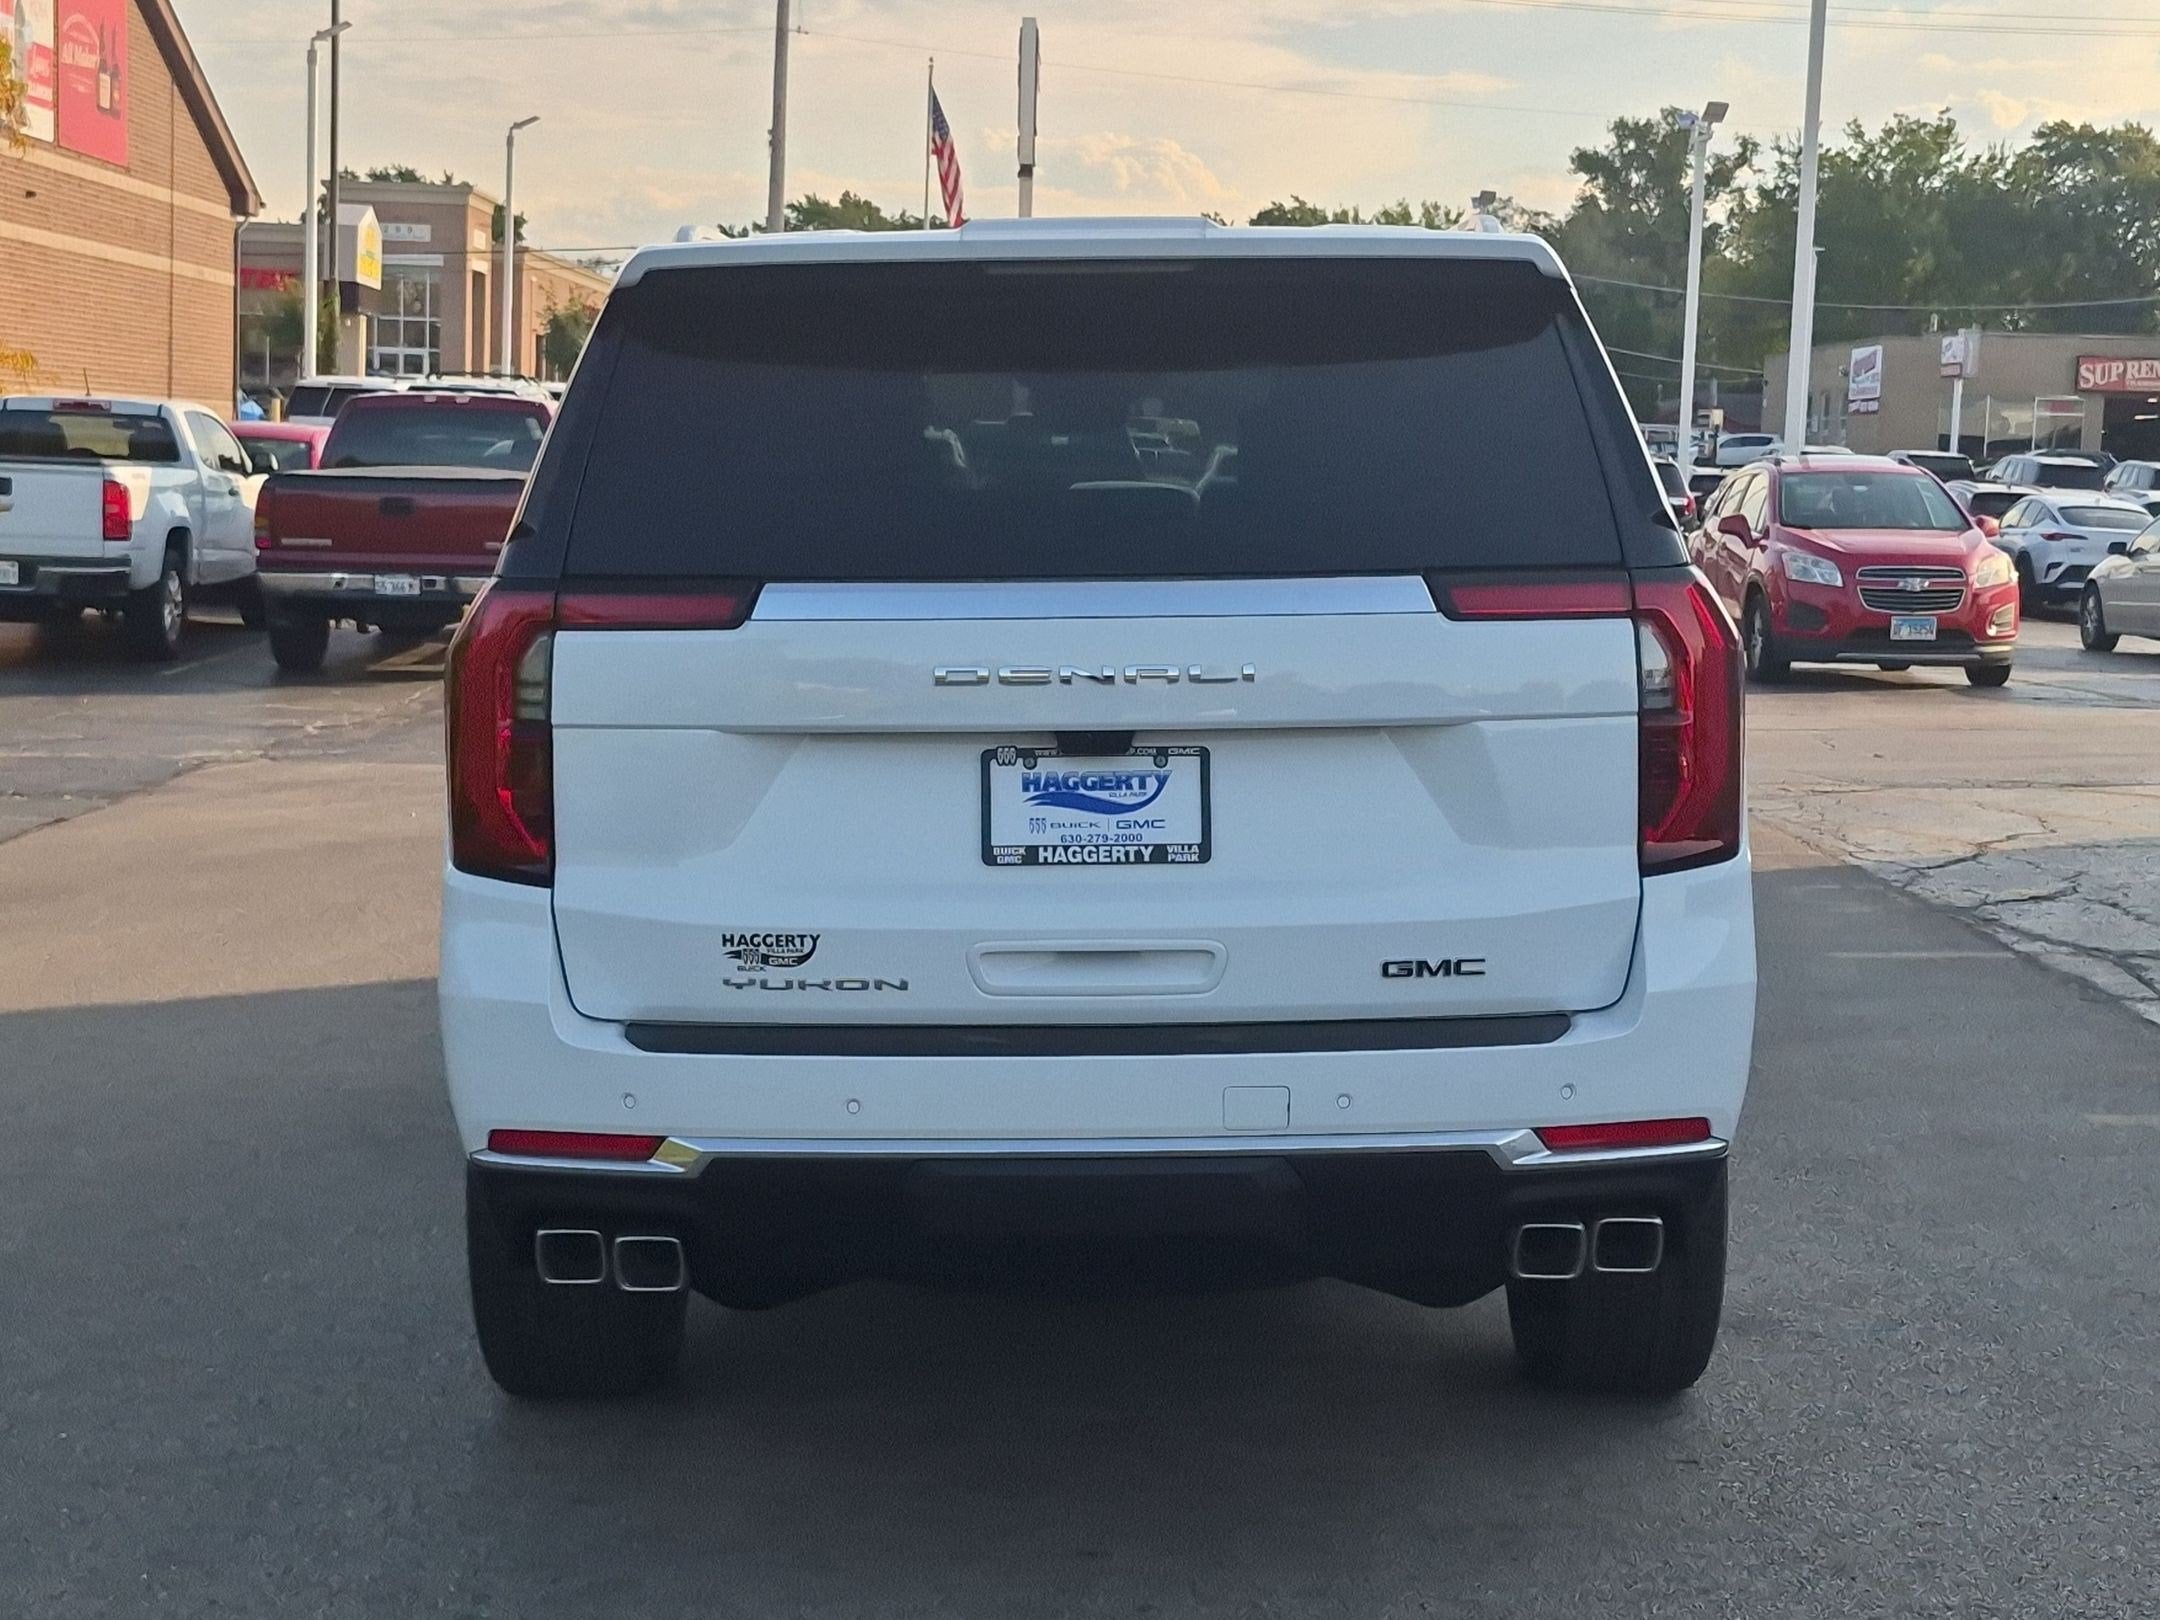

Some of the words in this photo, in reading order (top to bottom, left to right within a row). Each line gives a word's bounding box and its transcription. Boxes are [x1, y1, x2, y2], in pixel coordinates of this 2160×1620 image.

[934, 663, 1255, 685] DENALI
[1167, 747, 1201, 755] GMC
[1021, 769, 1173, 793] HAGGERTY
[1050, 821, 1101, 829] BUICK
[1116, 818, 1167, 830] GMC
[1060, 833, 1143, 844] 630-279-2000
[993, 846, 1026, 856] BUICK
[1038, 845, 1154, 864] HAGGERTY
[1166, 844, 1200, 854] VILLA
[996, 856, 1023, 865] GMC
[1167, 853, 1200, 863] PARK
[721, 933, 821, 948] HAGGERTY
[768, 957, 799, 966] GMC
[1381, 958, 1487, 978] GMC
[722, 978, 909, 991] YUKON
